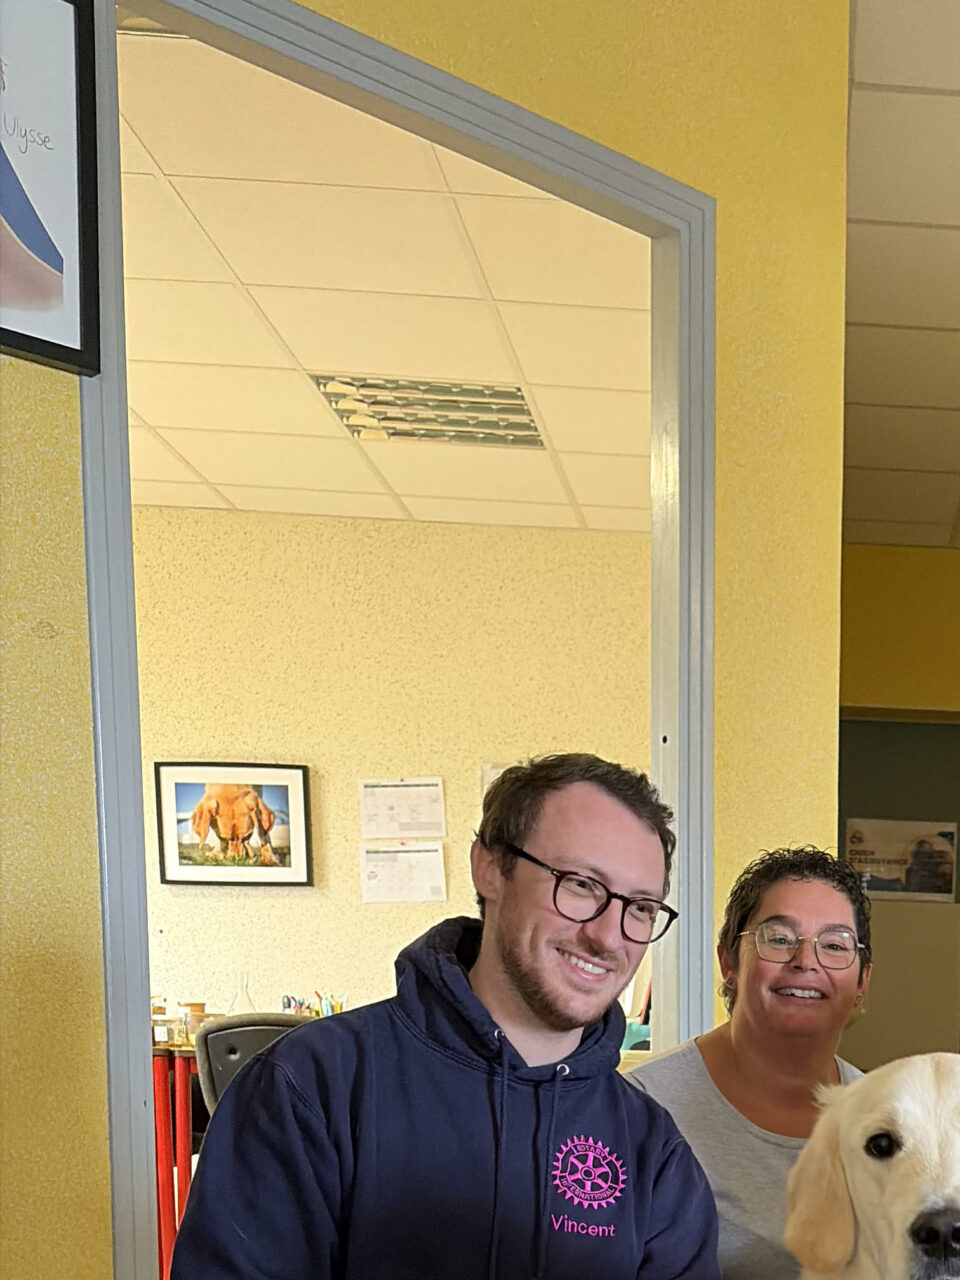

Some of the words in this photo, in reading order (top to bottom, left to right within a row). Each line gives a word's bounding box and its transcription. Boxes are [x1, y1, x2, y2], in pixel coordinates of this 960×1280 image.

[3, 112, 55, 154] Ulysse
[576, 1144, 606, 1157] ROTARY
[560, 1178, 615, 1200] INTERNATIONAL
[551, 1214, 616, 1237] Vincent
